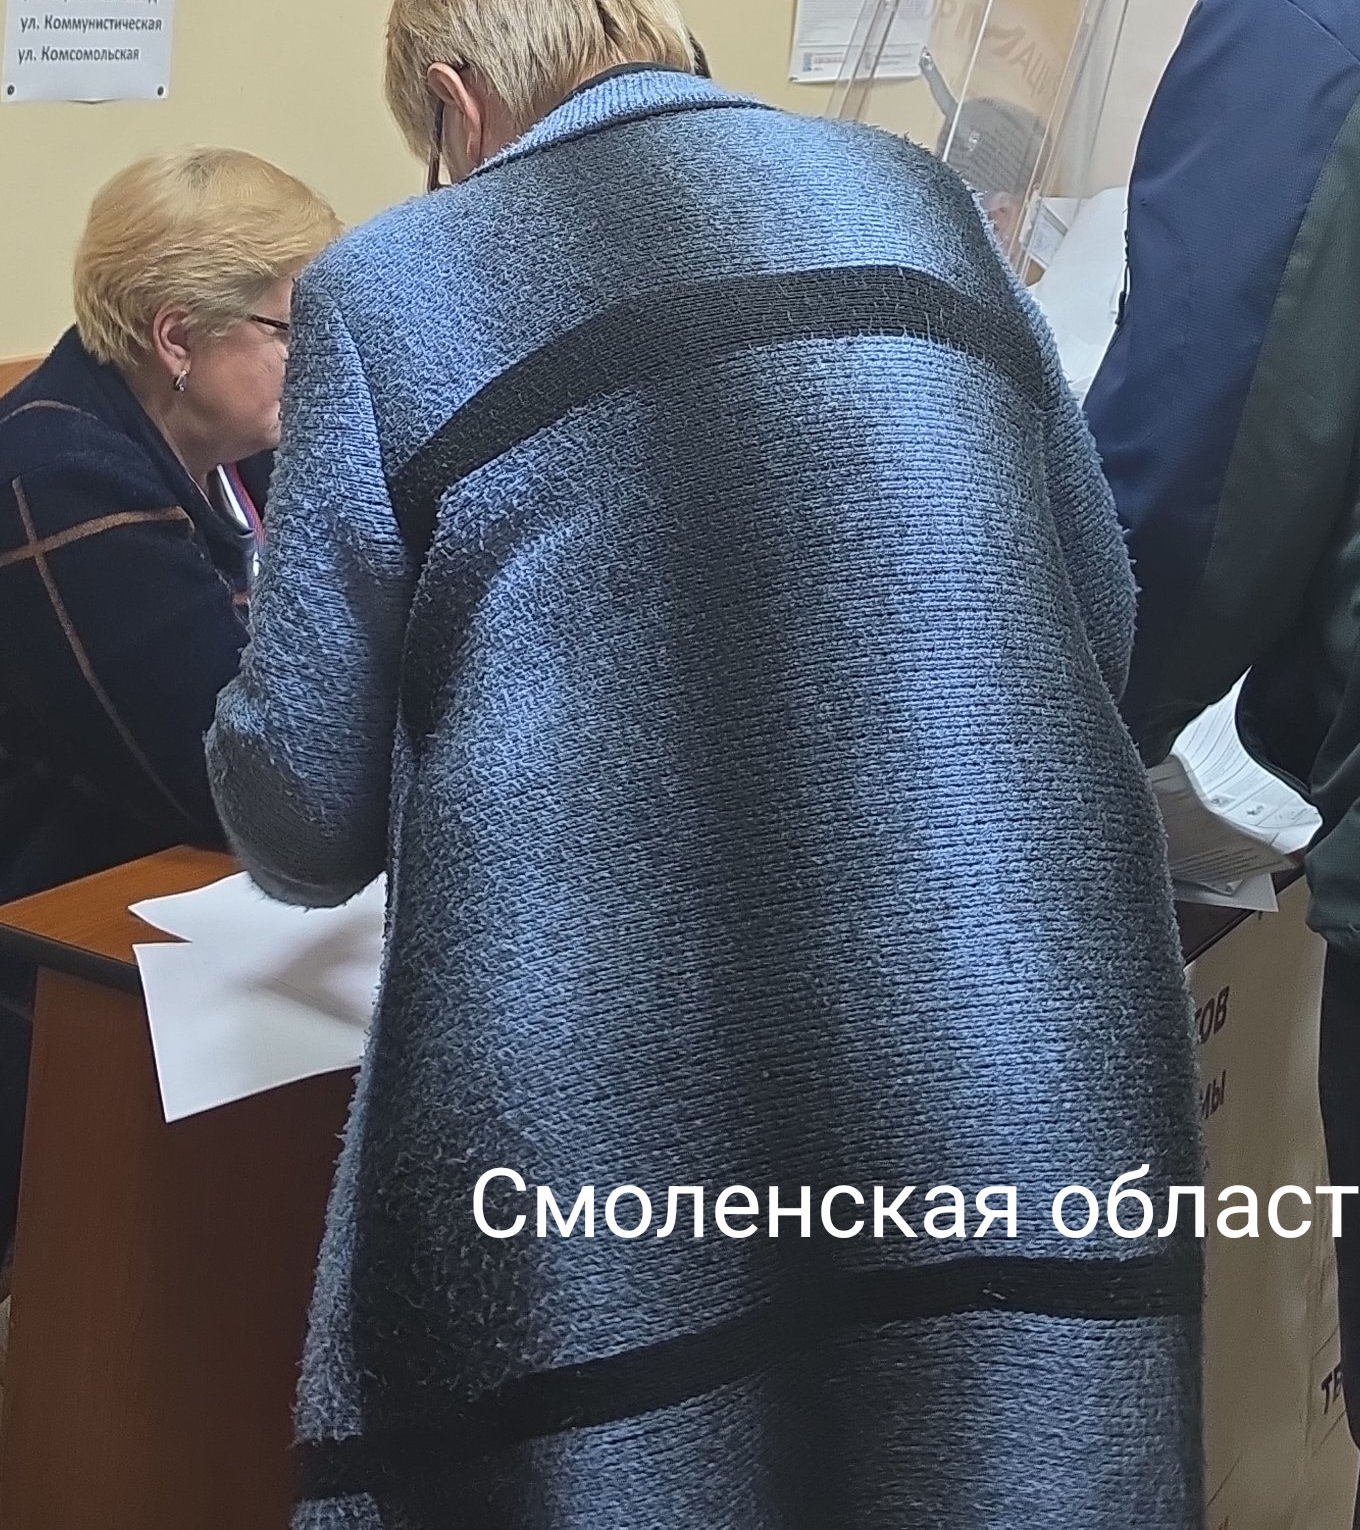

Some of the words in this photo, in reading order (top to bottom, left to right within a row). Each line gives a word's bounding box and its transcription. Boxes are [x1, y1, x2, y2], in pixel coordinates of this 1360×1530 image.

[20, 17, 40, 33] ул.
[44, 14, 162, 34] Коммунистическая
[18, 48, 37, 65] ул.
[41, 46, 140, 62] Комсомольская
